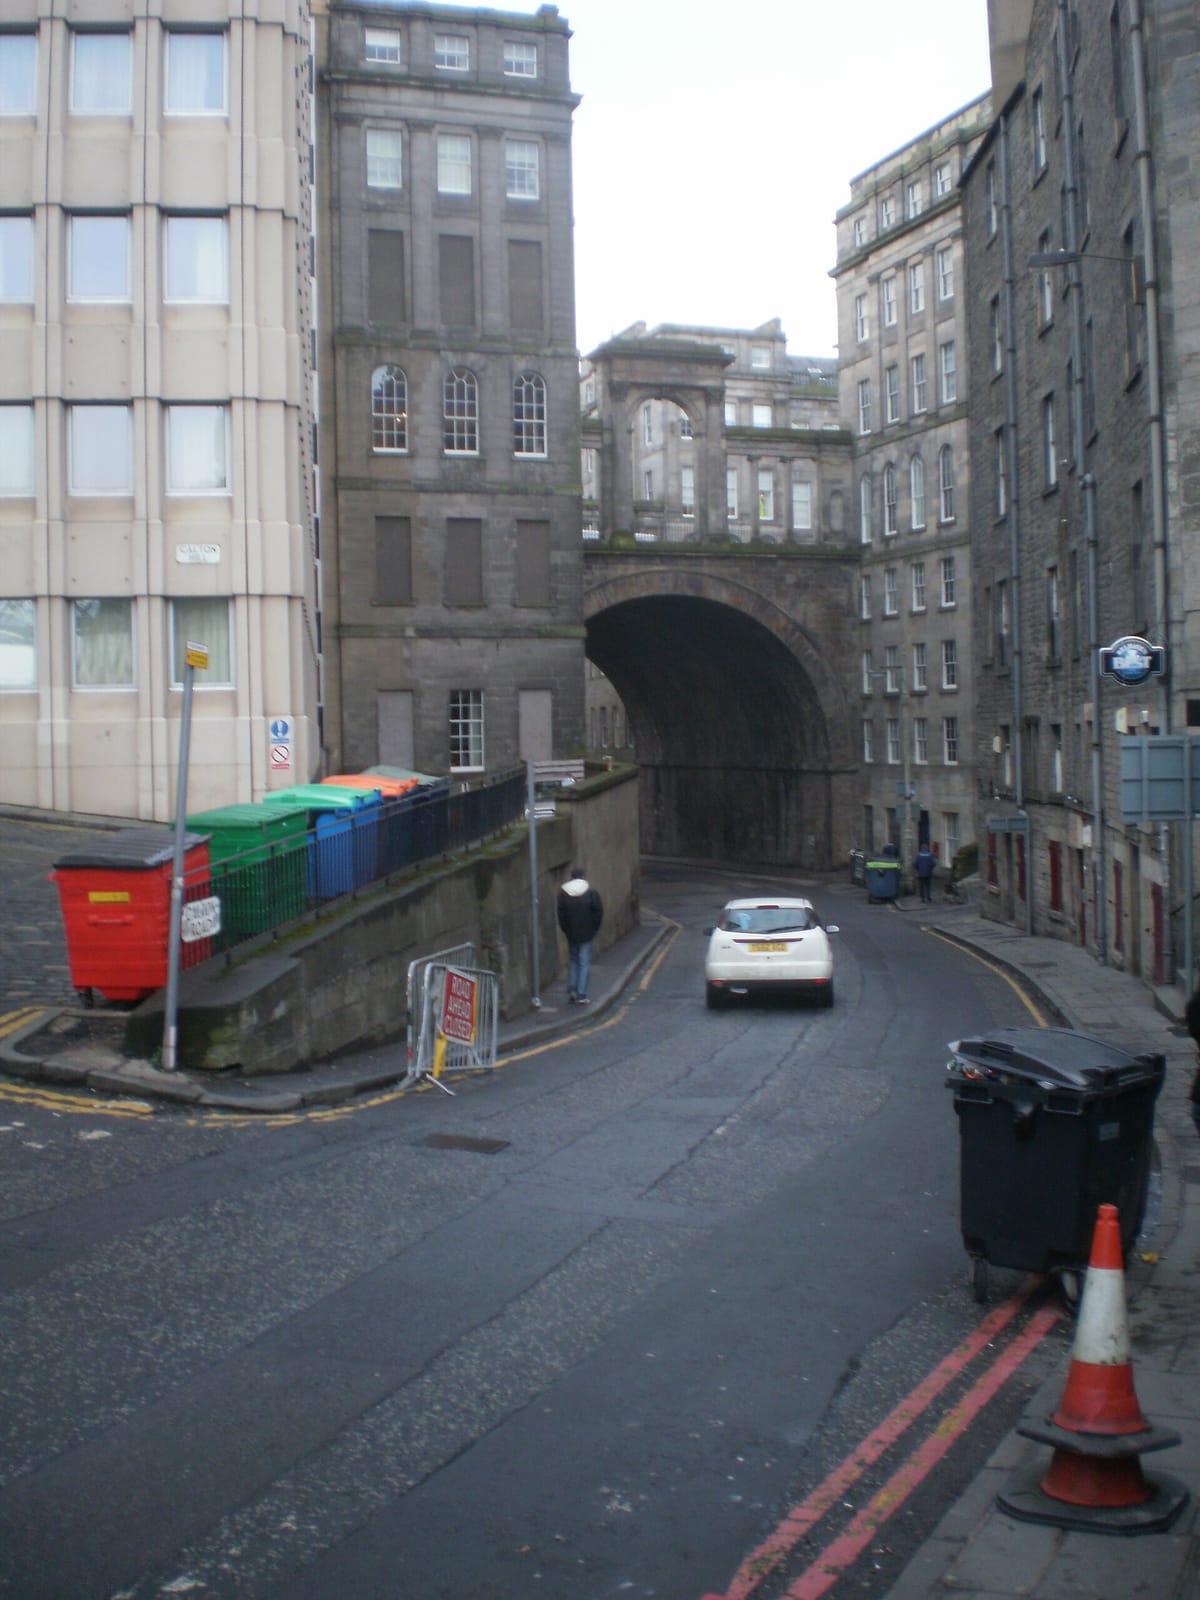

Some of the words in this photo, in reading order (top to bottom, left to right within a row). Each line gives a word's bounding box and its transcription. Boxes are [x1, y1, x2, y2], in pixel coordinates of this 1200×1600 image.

[451, 975, 472, 999] ROAD
[448, 995, 472, 1019] AHEAD
[444, 1014, 472, 1039] CLOSED
